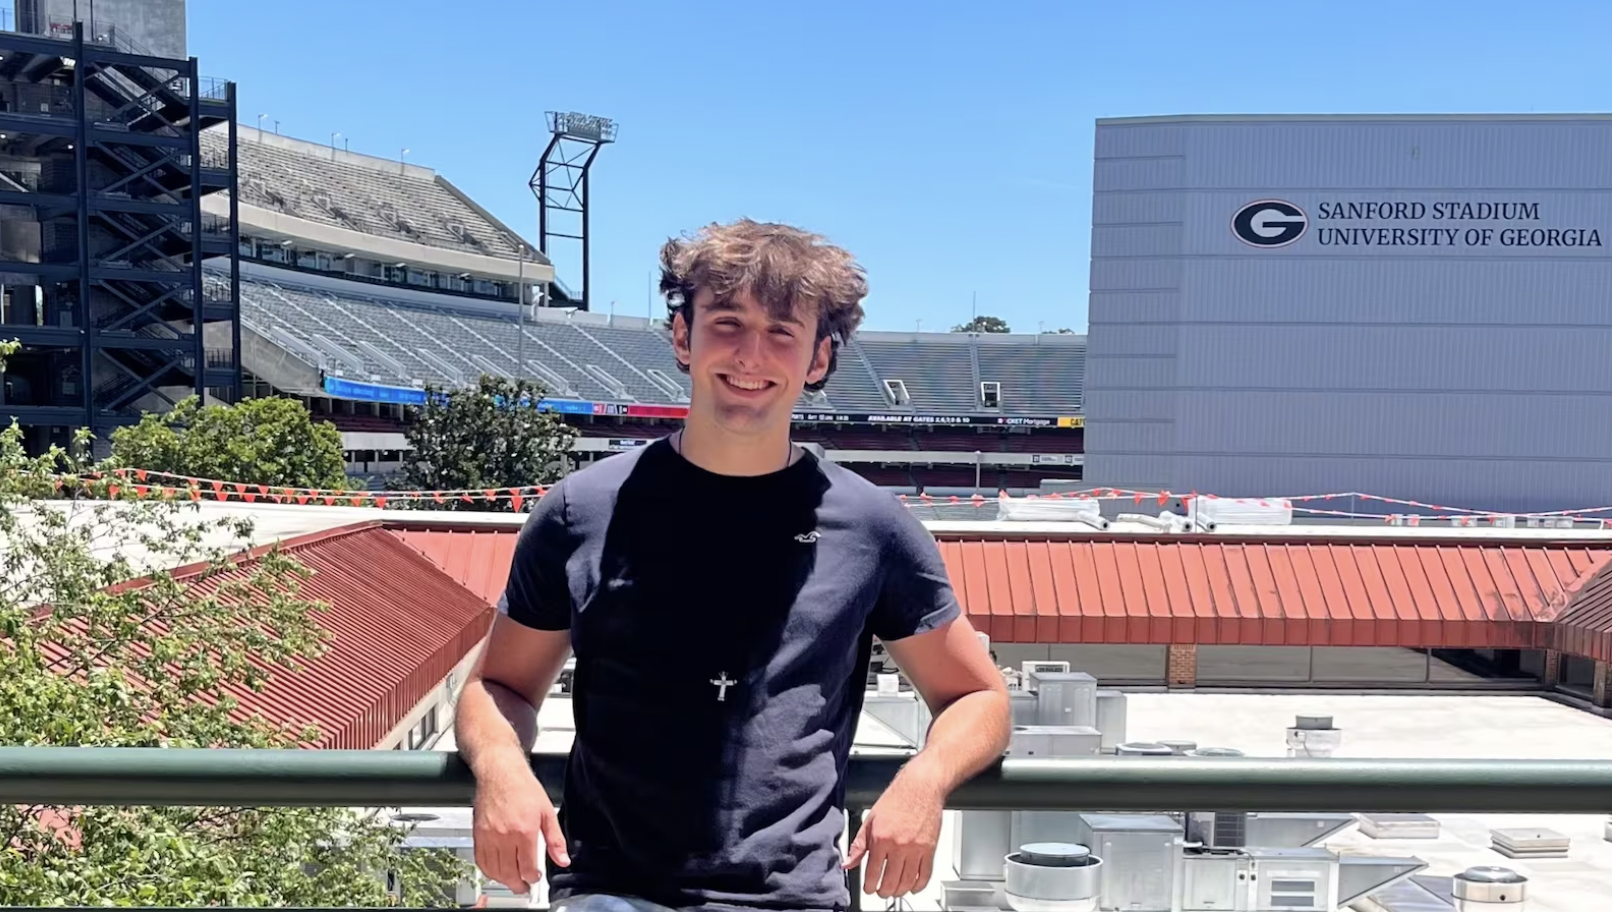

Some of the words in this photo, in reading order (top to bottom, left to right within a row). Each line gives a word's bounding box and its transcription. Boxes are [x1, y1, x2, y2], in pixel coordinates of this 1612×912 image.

[1317, 202, 1426, 220] SANFORD
[1432, 202, 1540, 220] STADIUM
[1318, 228, 1460, 246] UNIVERSITY
[1464, 228, 1494, 246] OF
[1499, 228, 1602, 247] GEORGIA
